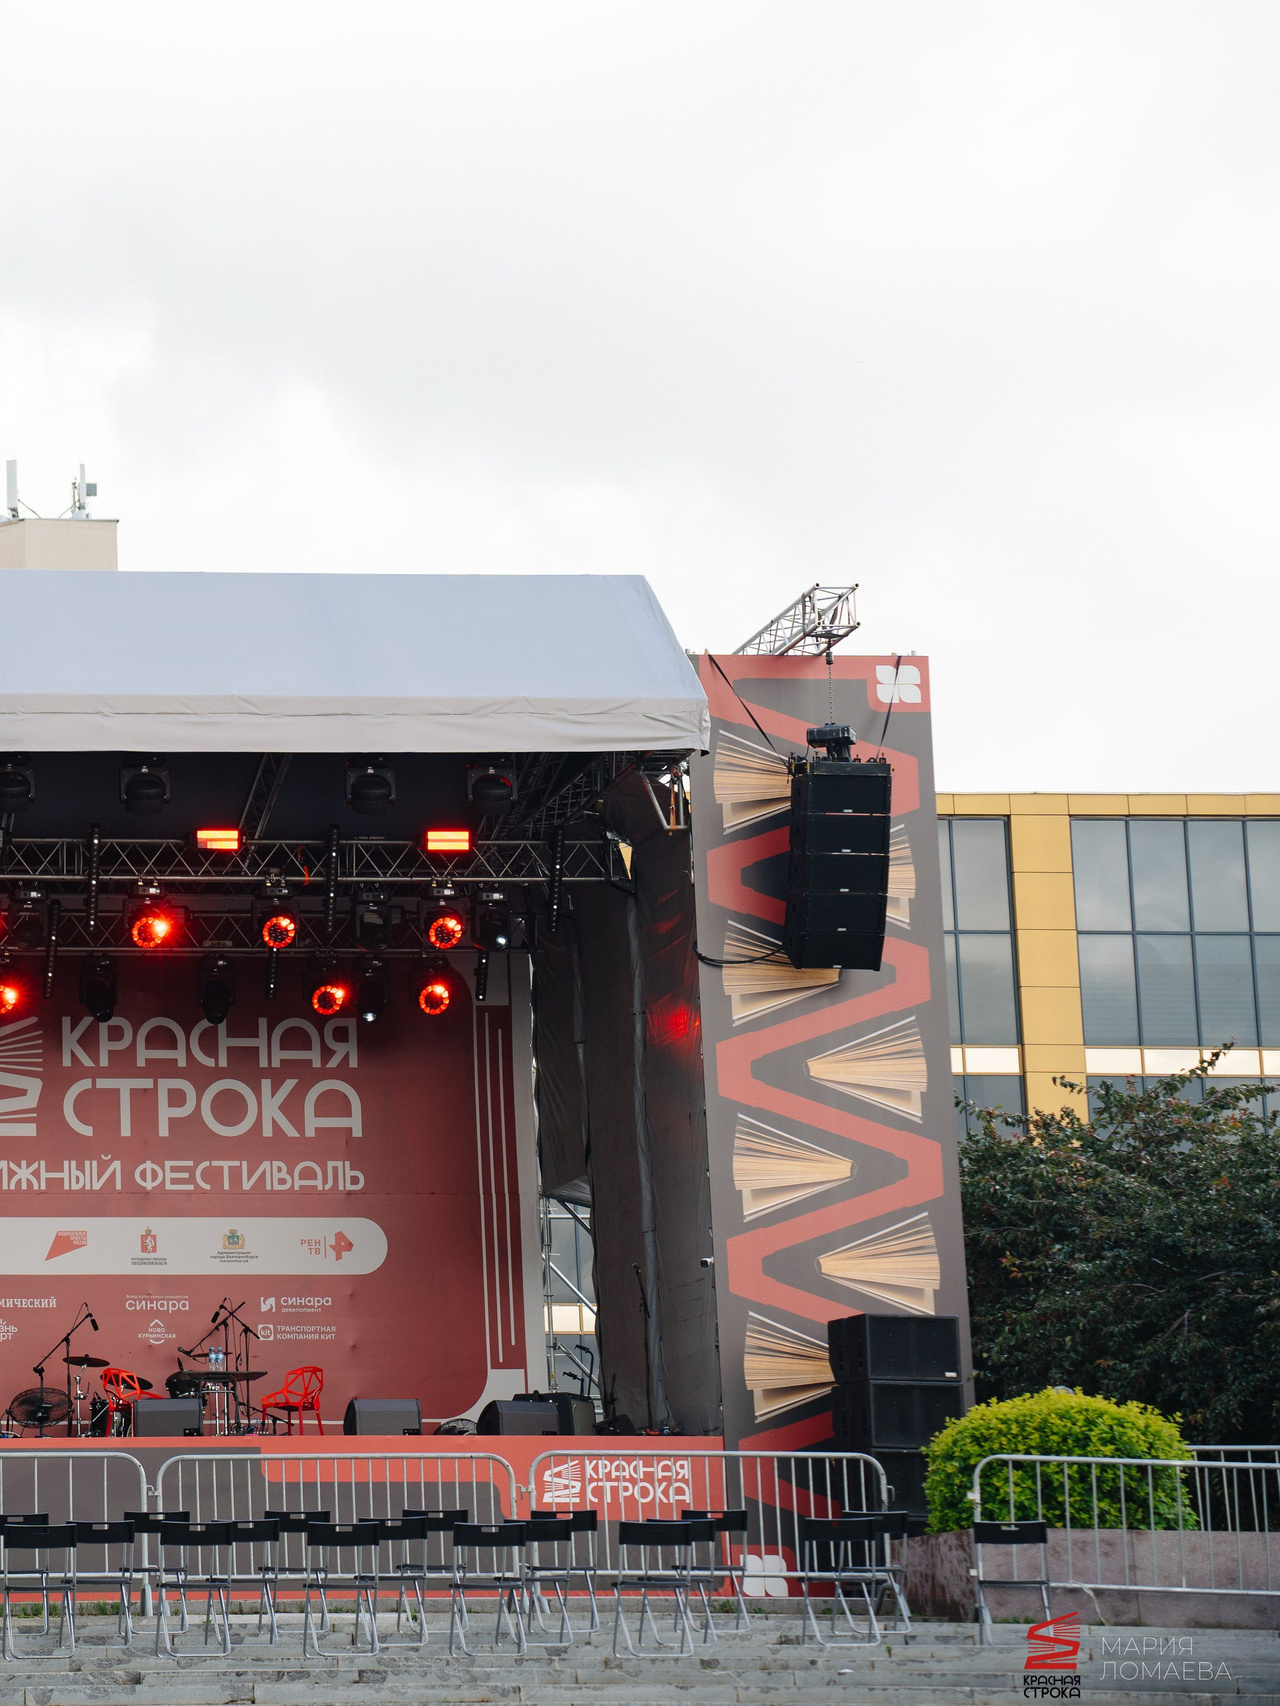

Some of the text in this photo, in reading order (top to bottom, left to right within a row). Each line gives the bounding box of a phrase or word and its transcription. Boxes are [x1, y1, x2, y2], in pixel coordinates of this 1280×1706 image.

[61, 1015, 359, 1069] КРАСНАЯ
[62, 1077, 363, 1138] СТРОКА
[133, 1159, 365, 1191] ФЕСТИВАЛЬ
[300, 1239, 321, 1247] РЕН
[307, 1247, 321, 1255] ТВ
[125, 1300, 190, 1314] синара
[280, 1296, 332, 1308] синара
[260, 1328, 272, 1336] kit
[586, 1459, 690, 1480] КРАСНАЯ
[587, 1481, 690, 1504] СТРОКА
